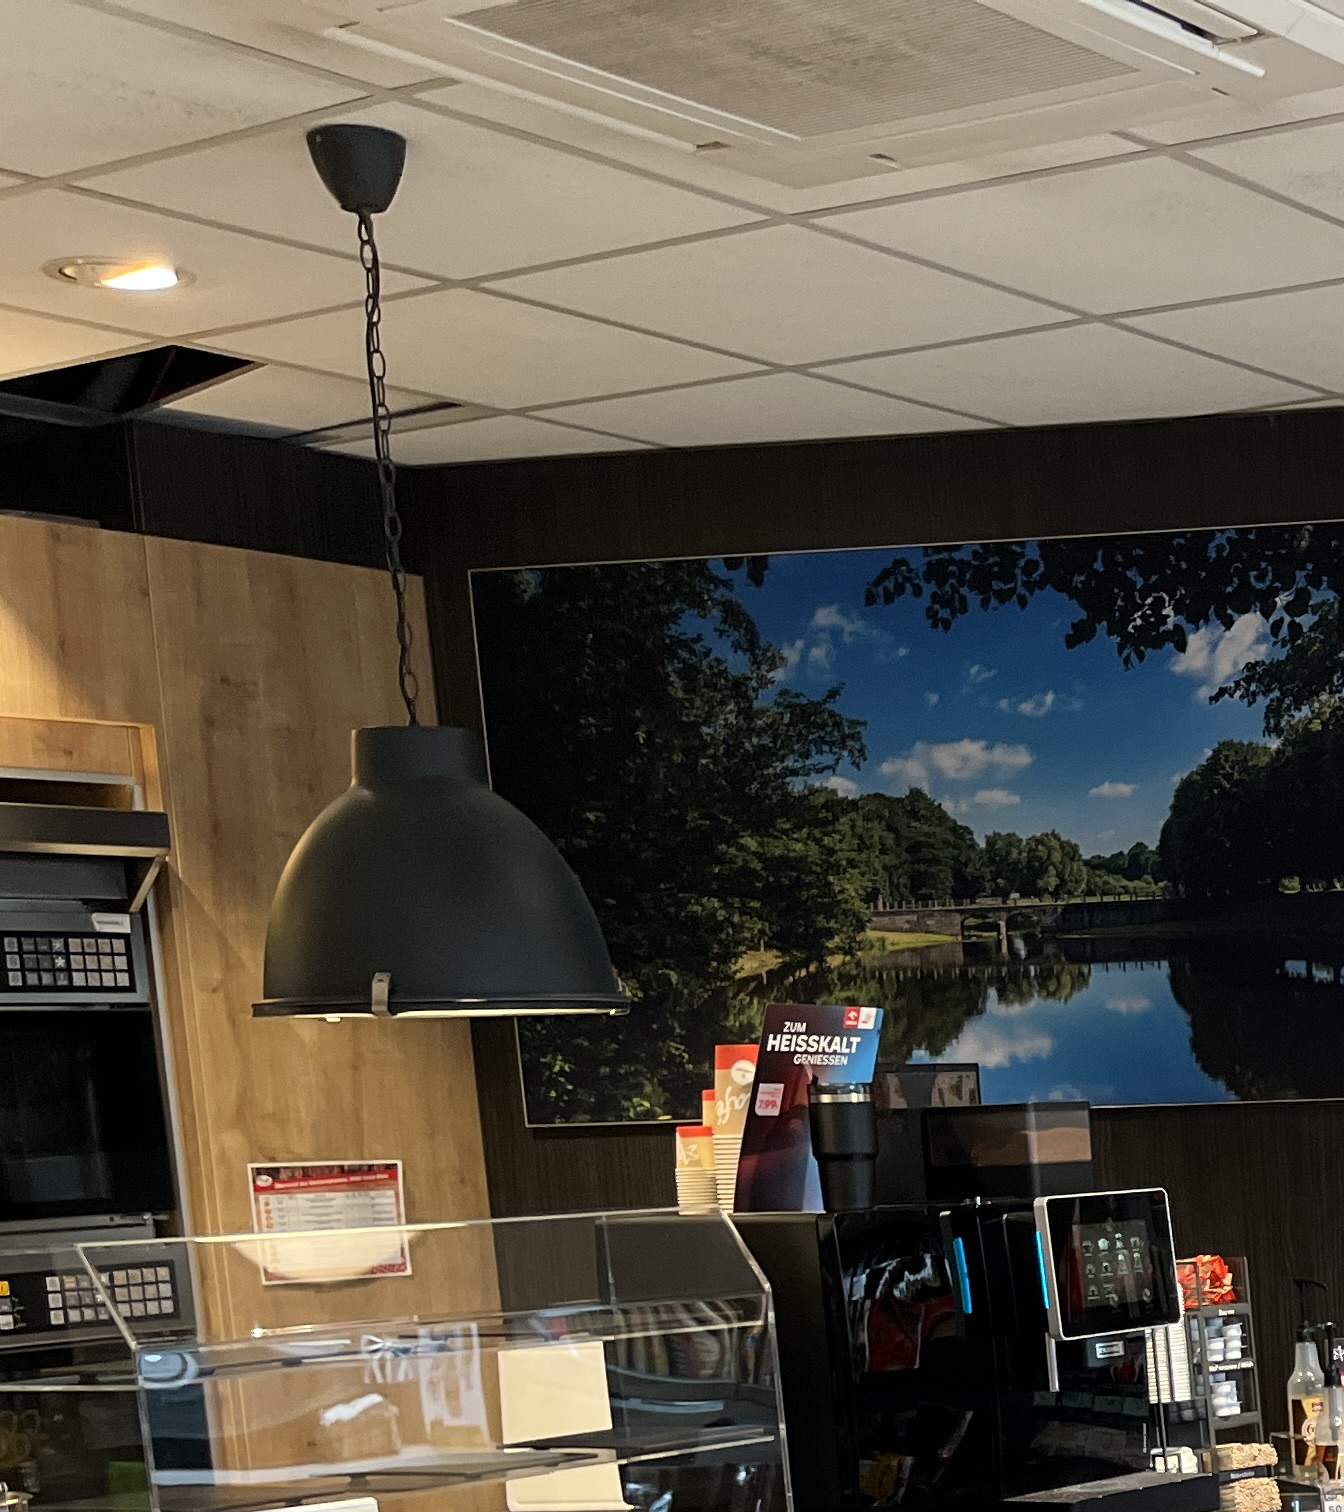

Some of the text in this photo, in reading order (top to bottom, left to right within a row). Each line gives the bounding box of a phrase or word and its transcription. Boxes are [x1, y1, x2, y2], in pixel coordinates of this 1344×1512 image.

[783, 1022, 807, 1032] ZUM
[766, 1034, 861, 1053] HEISSKALT
[793, 1054, 849, 1065] GENIESSEN
